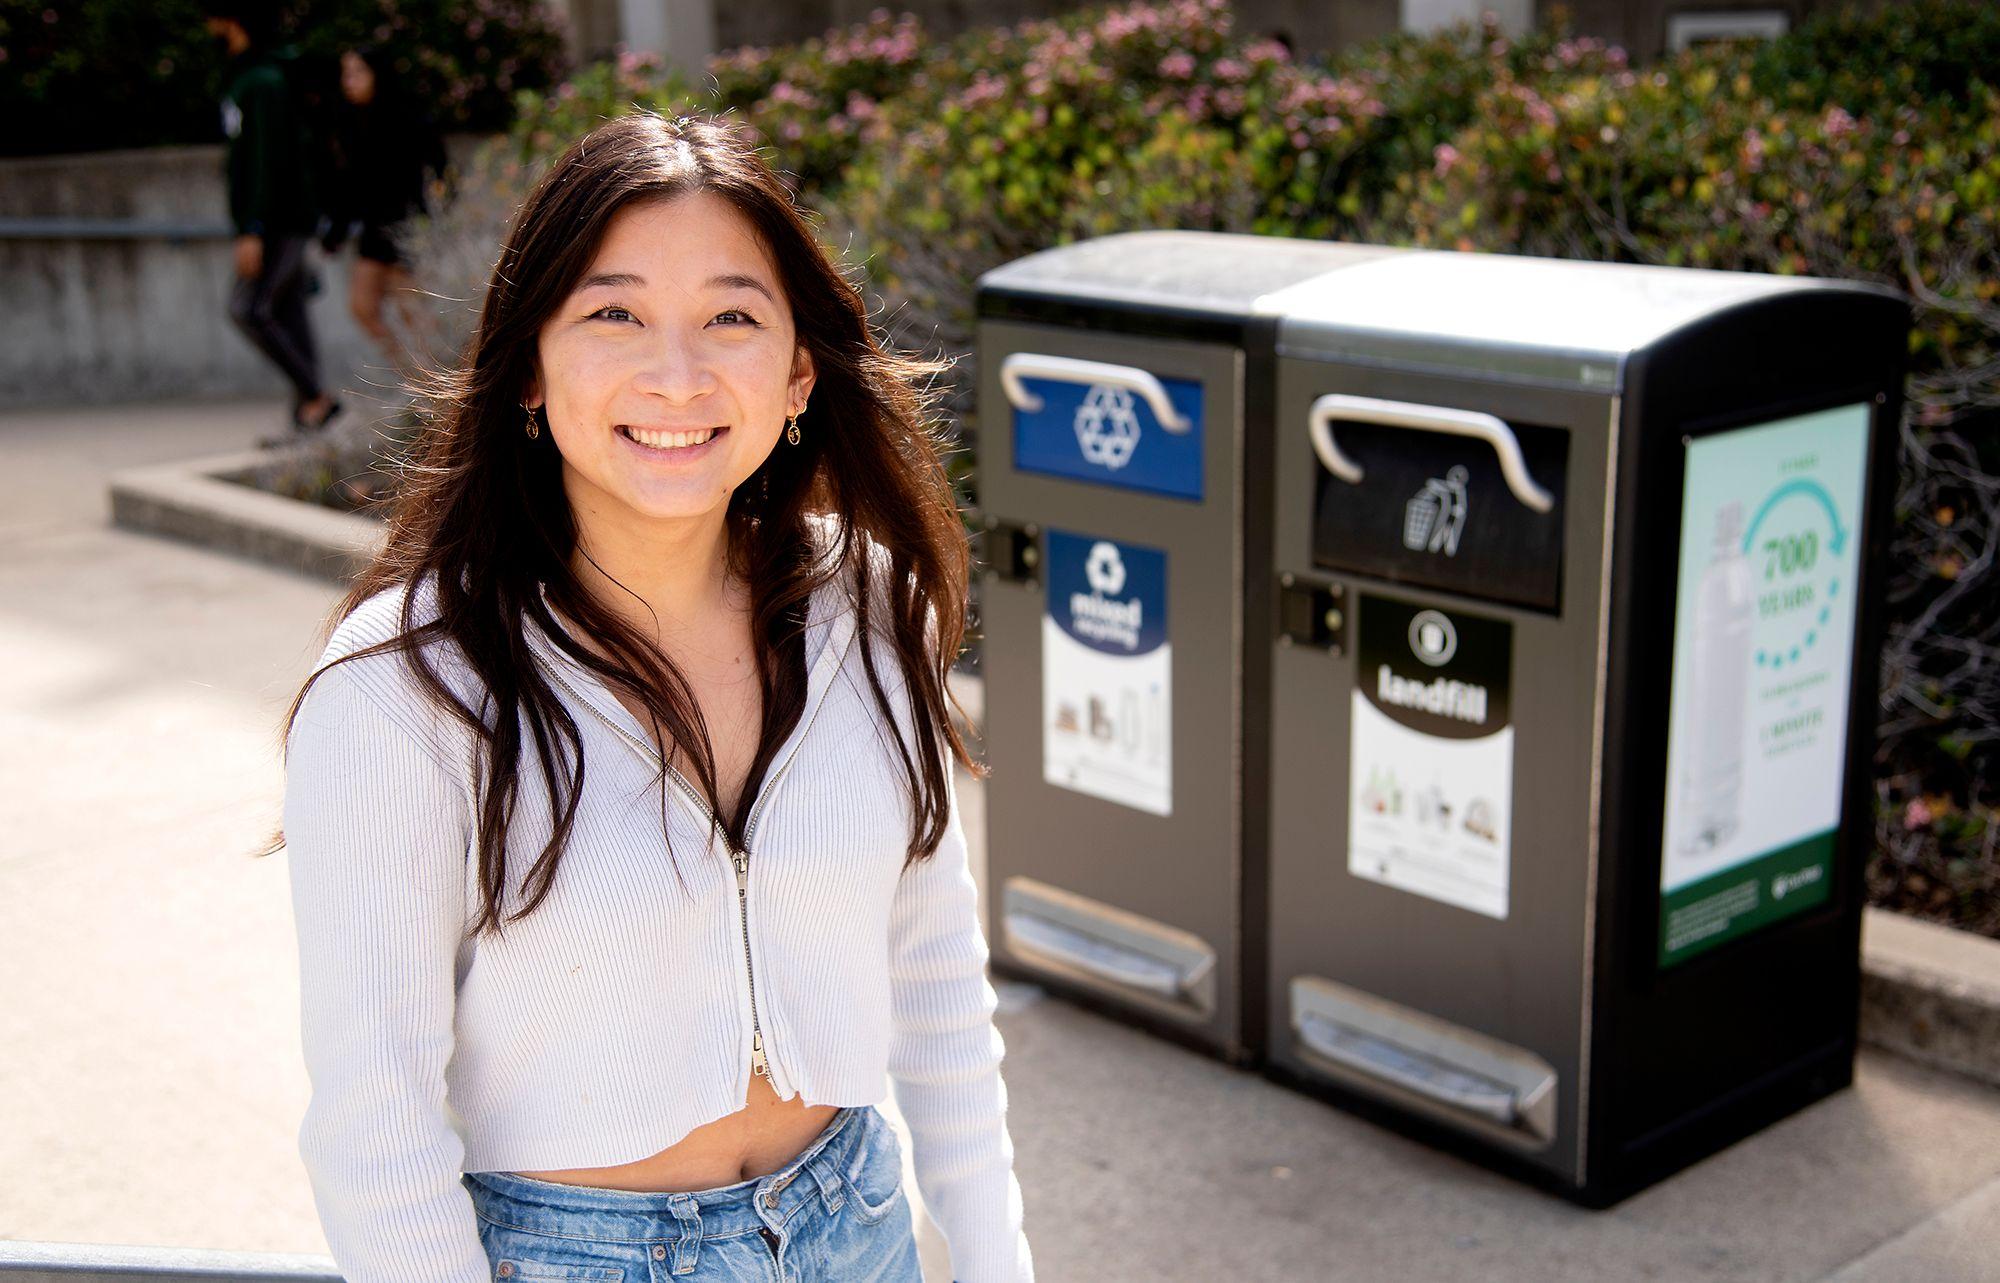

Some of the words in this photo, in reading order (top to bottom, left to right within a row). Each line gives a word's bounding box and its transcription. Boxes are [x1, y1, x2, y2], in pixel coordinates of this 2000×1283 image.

[1762, 530, 1818, 580] 700
[1070, 592, 1142, 629] mixed
[1378, 664, 1487, 724] landfill
